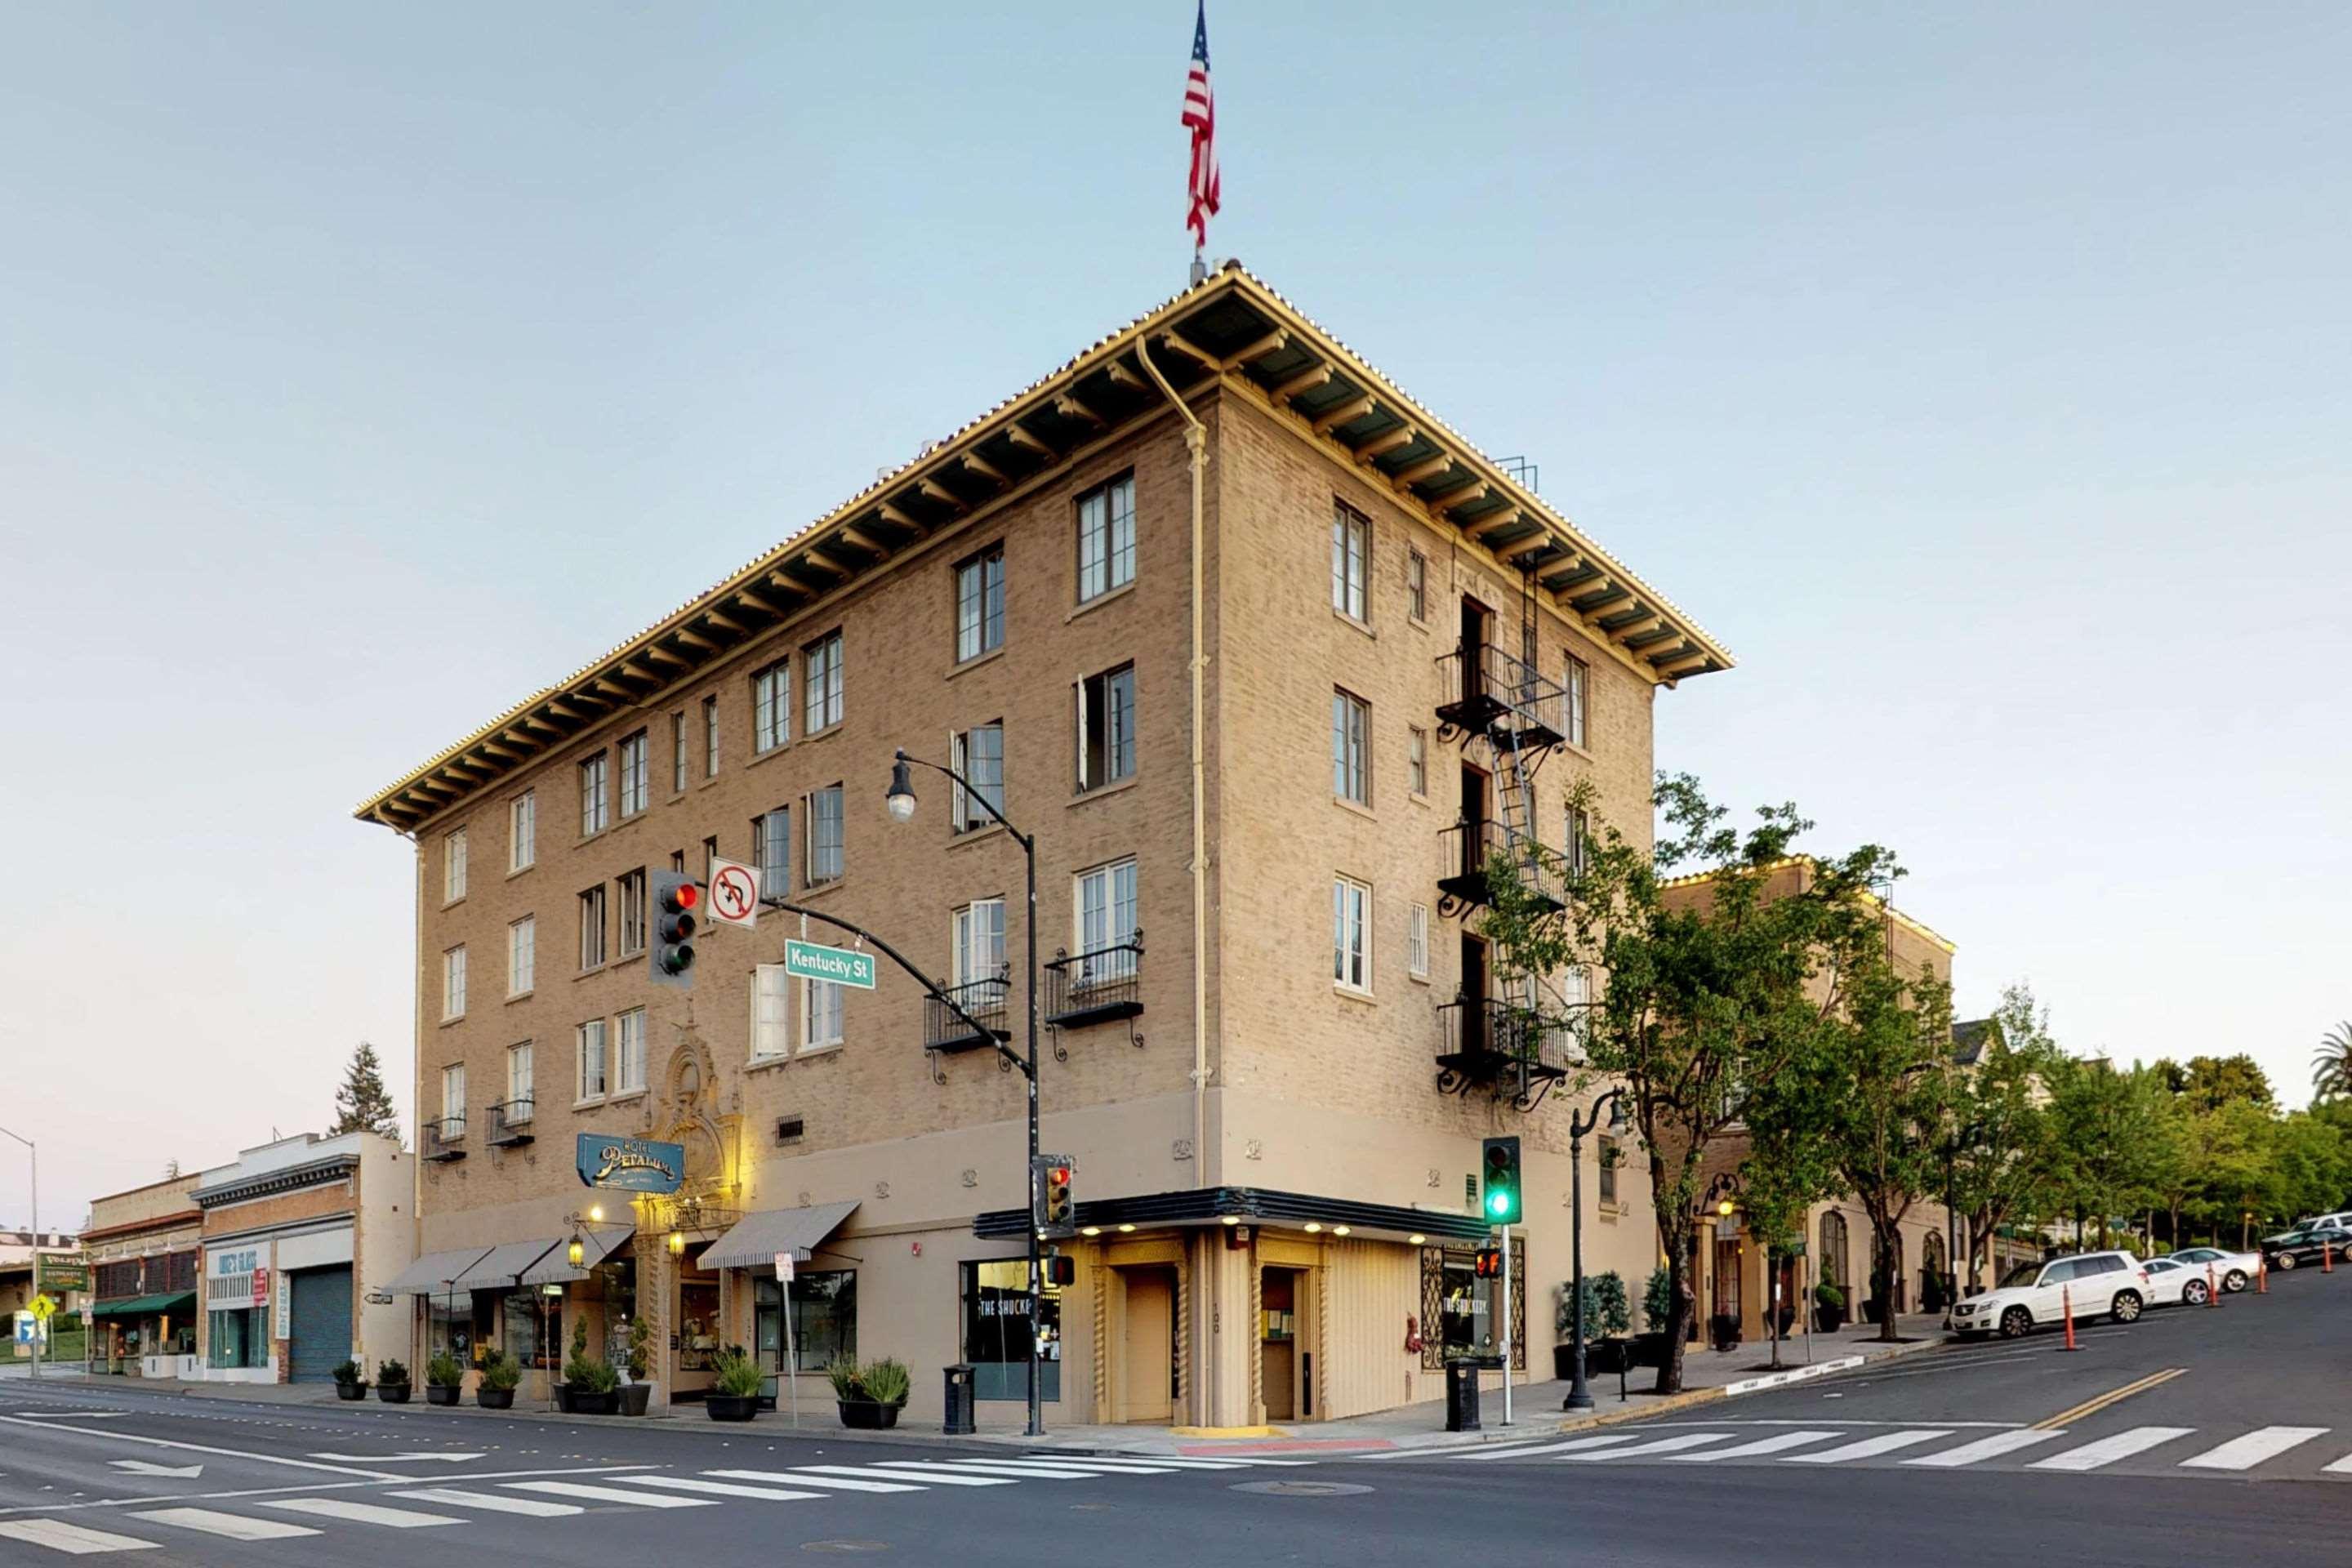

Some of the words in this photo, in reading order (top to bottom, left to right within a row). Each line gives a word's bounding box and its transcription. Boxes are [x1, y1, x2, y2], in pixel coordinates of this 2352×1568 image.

[791, 948, 850, 978] Kentucky
[853, 960, 867, 978] St
[623, 1140, 652, 1153] HOTEL
[980, 1300, 995, 1316] THE
[998, 1298, 1032, 1315] SHUCKE
